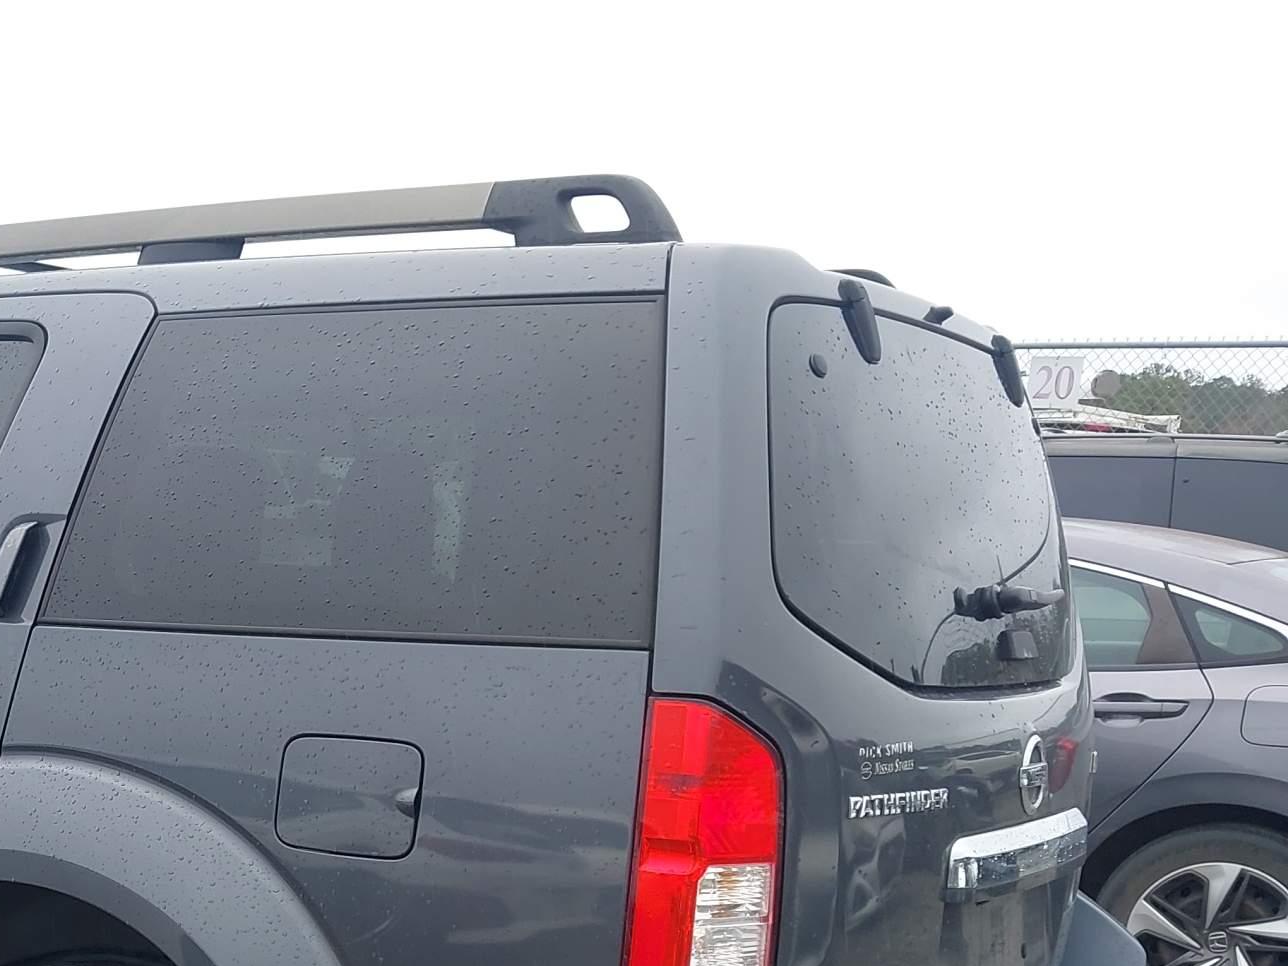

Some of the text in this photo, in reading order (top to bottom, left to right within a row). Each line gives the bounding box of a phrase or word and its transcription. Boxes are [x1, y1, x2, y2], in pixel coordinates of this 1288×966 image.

[1032, 365, 1075, 400] 20
[859, 740, 914, 758] DICK SMITH
[848, 787, 949, 819] PATHFINDER
